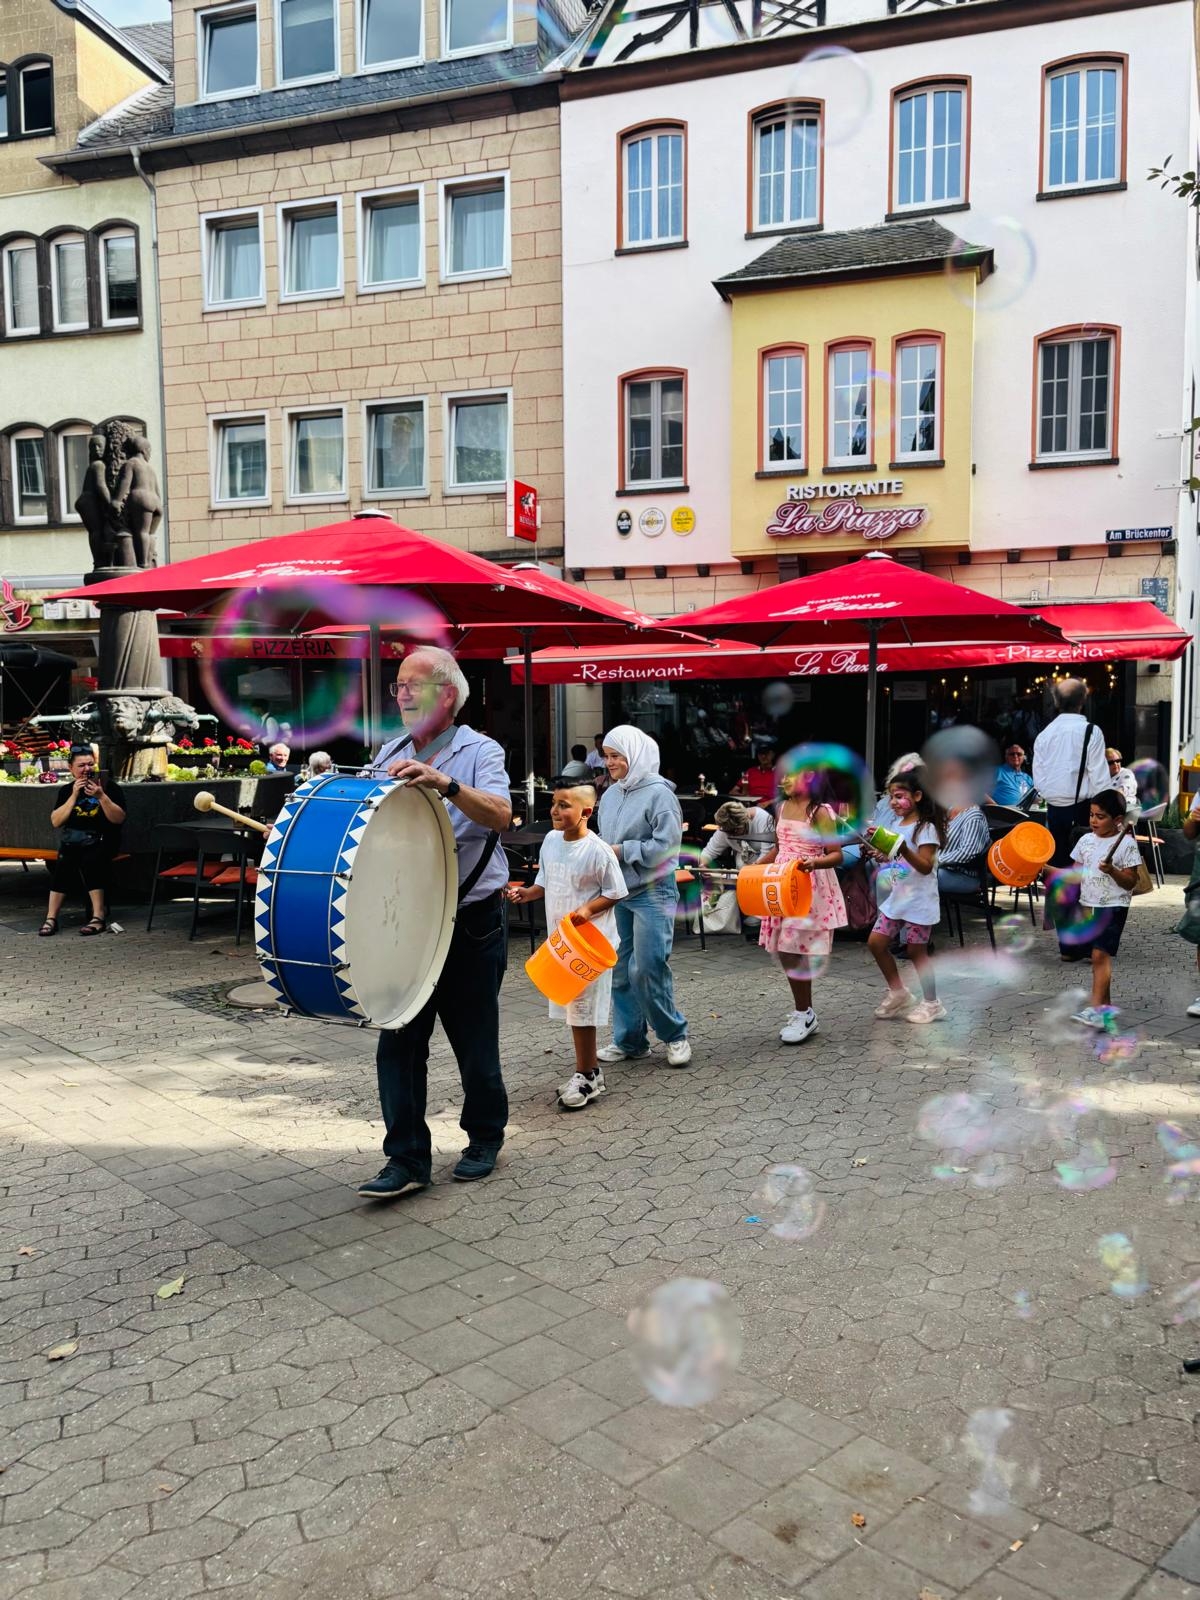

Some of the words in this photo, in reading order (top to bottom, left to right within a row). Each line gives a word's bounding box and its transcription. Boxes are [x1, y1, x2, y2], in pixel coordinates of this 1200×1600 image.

[786, 479, 904, 500] RISTORANTE
[766, 501, 818, 536] La
[816, 497, 927, 540] Piazza
[1109, 531, 1122, 540] Am
[1125, 528, 1170, 539] Brückentor
[251, 640, 336, 656] PIZZERIA
[788, 651, 820, 677] La
[827, 650, 889, 674] Piaza
